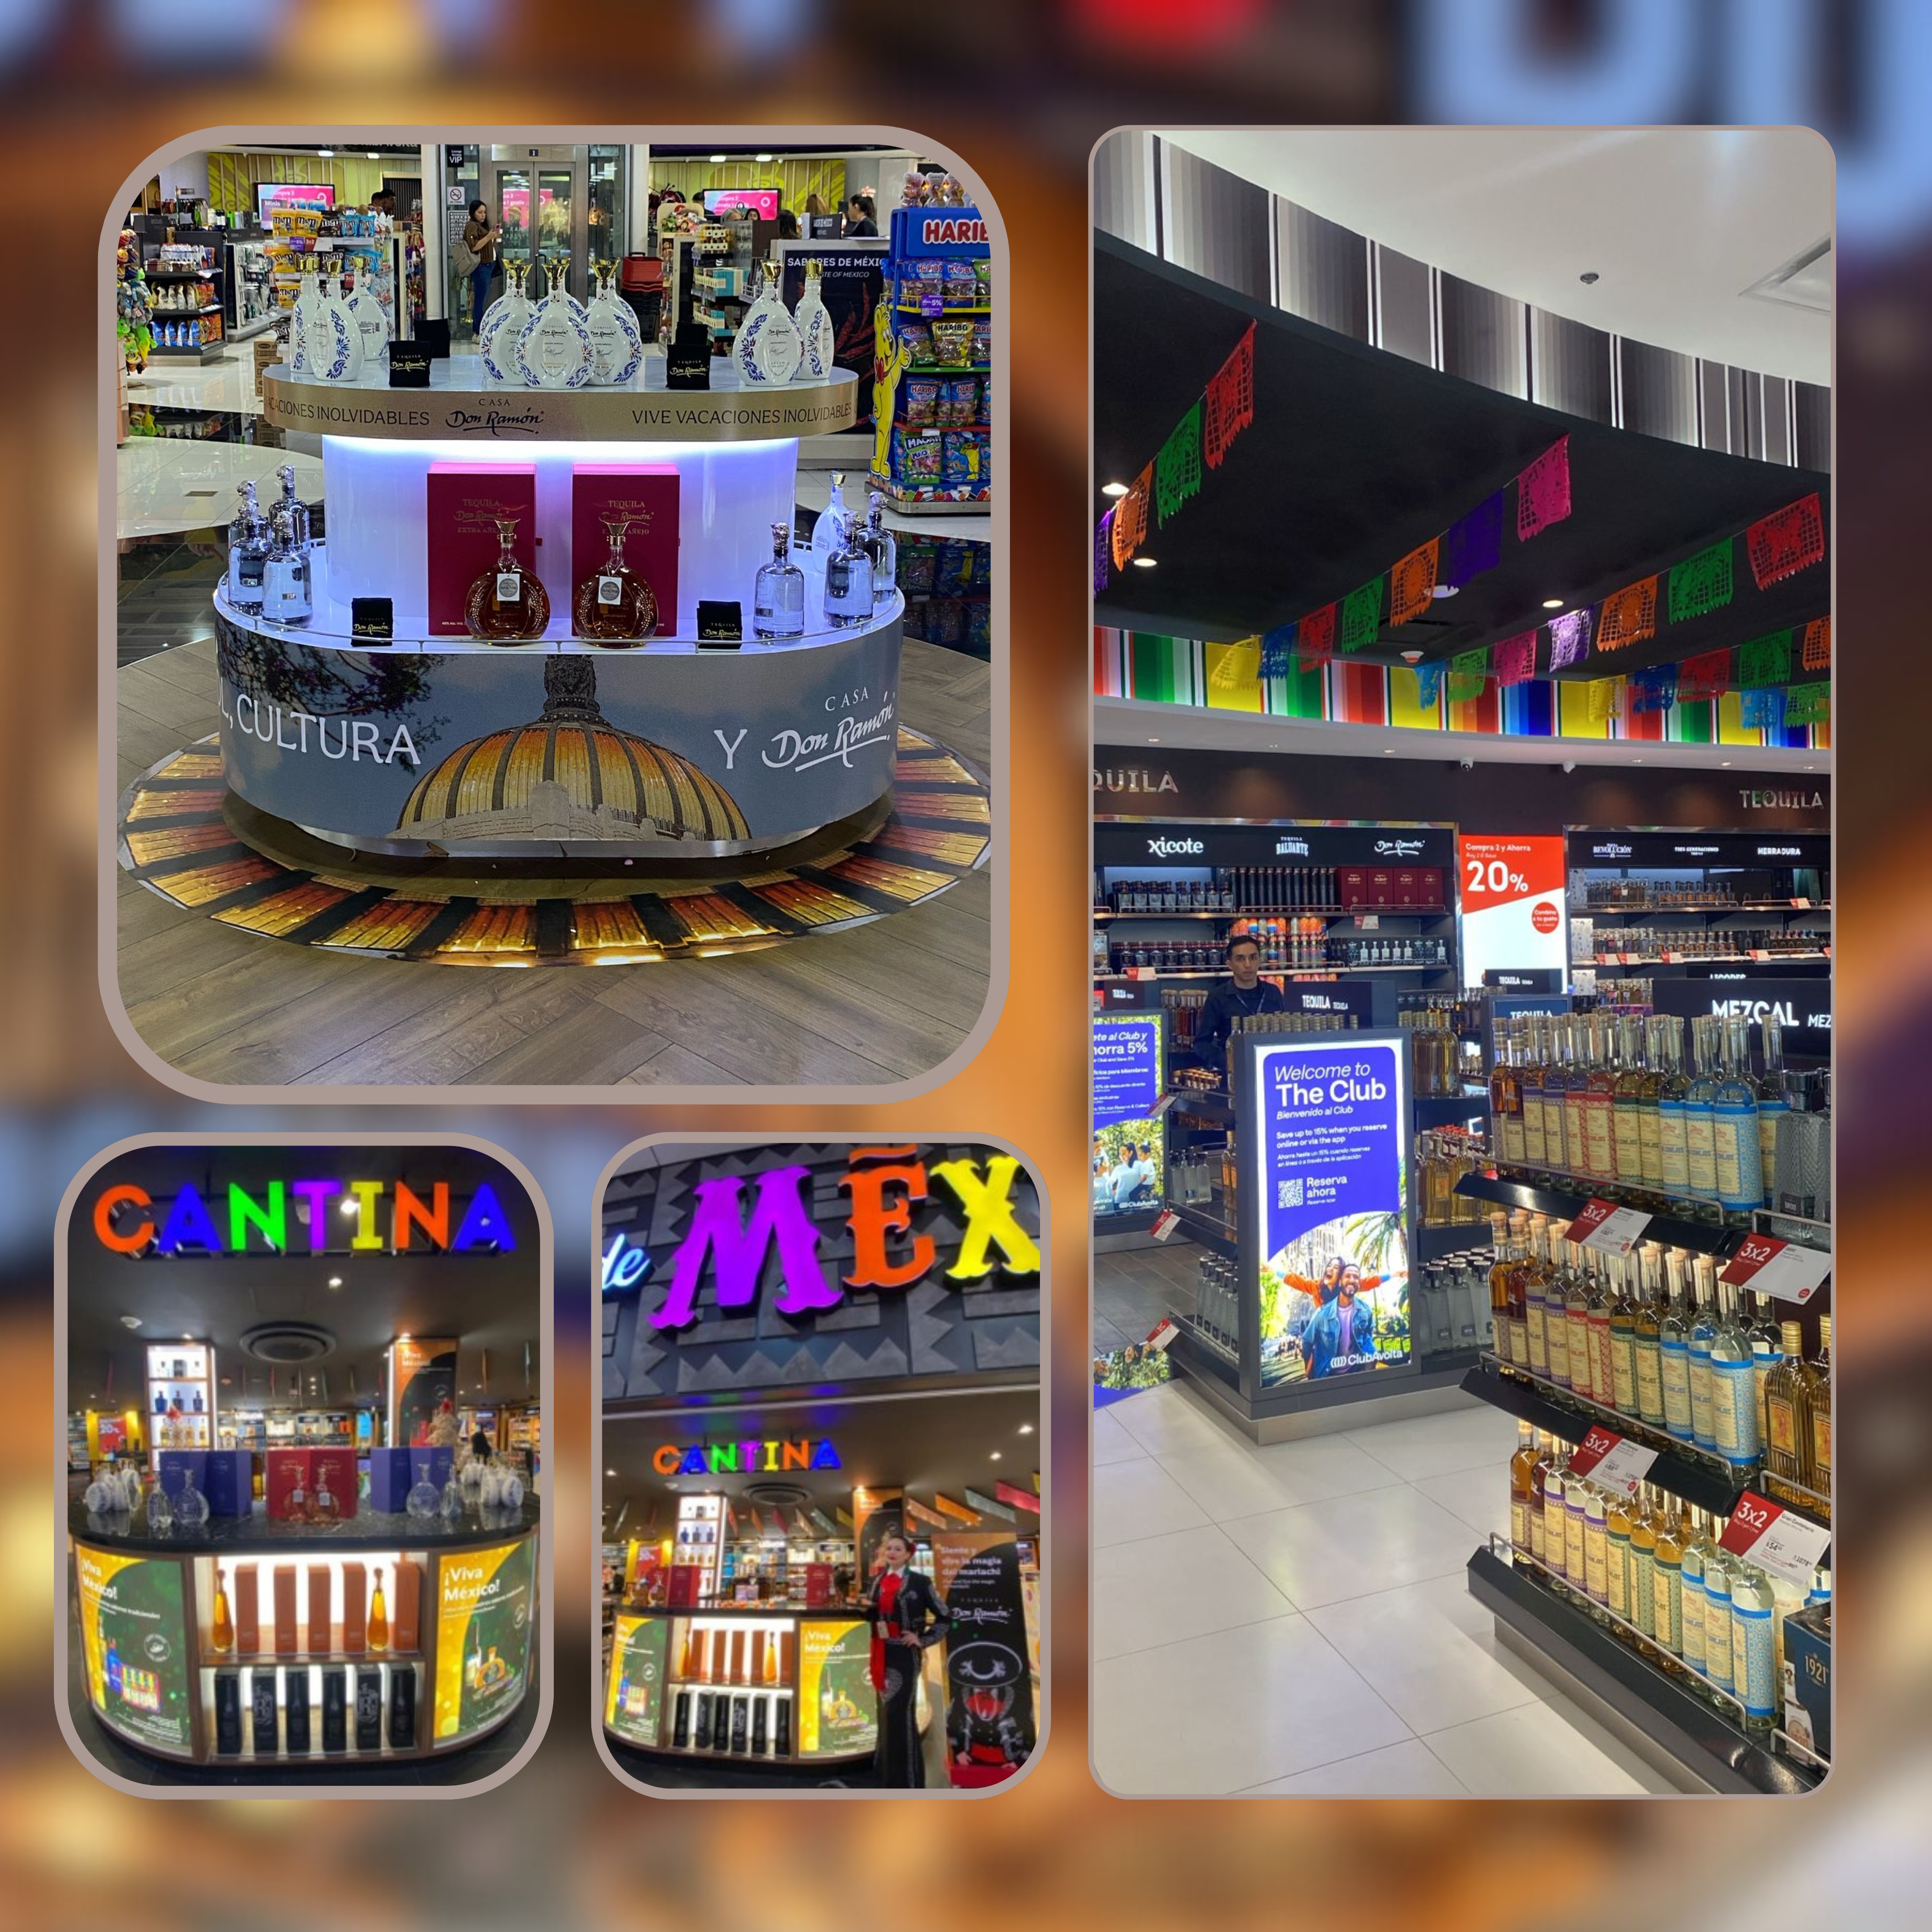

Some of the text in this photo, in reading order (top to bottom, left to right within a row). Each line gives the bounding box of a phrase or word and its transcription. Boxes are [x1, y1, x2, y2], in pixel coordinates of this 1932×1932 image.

[787, 258, 836, 266] SABRES
[854, 256, 882, 266] MÉXI
[318, 406, 429, 426] INOLVIDABLES
[446, 407, 544, 436] Don Ramón
[632, 402, 852, 424] VIVE VACACIONES INOLVIDABLES
[608, 500, 645, 509] TEQUILA
[825, 687, 868, 711] CASA
[237, 694, 421, 764] CULTURA
[714, 729, 747, 769] Y
[762, 691, 894, 768] Don Ramón
[1740, 790, 1824, 809] TEQUILA
[1147, 836, 1204, 857] xicote
[1276, 842, 1308, 857] BALUARTE
[1374, 840, 1392, 852] Don
[1758, 847, 1800, 856] HERRADURA
[1467, 860, 1529, 892] 20%
[1302, 995, 1331, 1009] TEQUILA
[1712, 999, 1800, 1026] MEZCAL
[1108, 1032, 1148, 1041] al Club y
[1127, 1042, 1148, 1054] 5%
[1275, 1062, 1370, 1082] Welcome to
[1275, 1078, 1387, 1107] The Club
[1277, 1105, 1354, 1120] Bienvenido al Club
[1277, 1140, 1298, 1149] online
[1307, 1176, 1347, 1187] Reserva
[1307, 1187, 1336, 1198] ahora
[94, 1181, 516, 1252] CANTINA
[1583, 1204, 1607, 1221] 3x2
[1741, 1243, 1770, 1261] 3x2
[1348, 1349, 1403, 1366] ClubAvolta
[1586, 1433, 1609, 1454] 3x2
[654, 1438, 841, 1475] CANTINA
[1738, 1501, 1767, 1528] 3x2
[973, 1557, 1002, 1566] magia
[444, 1567, 483, 1586] ¡Viva
[444, 1579, 500, 1601] México!
[951, 1607, 971, 1619] Don
[1805, 1656, 1826, 1684] 1921
